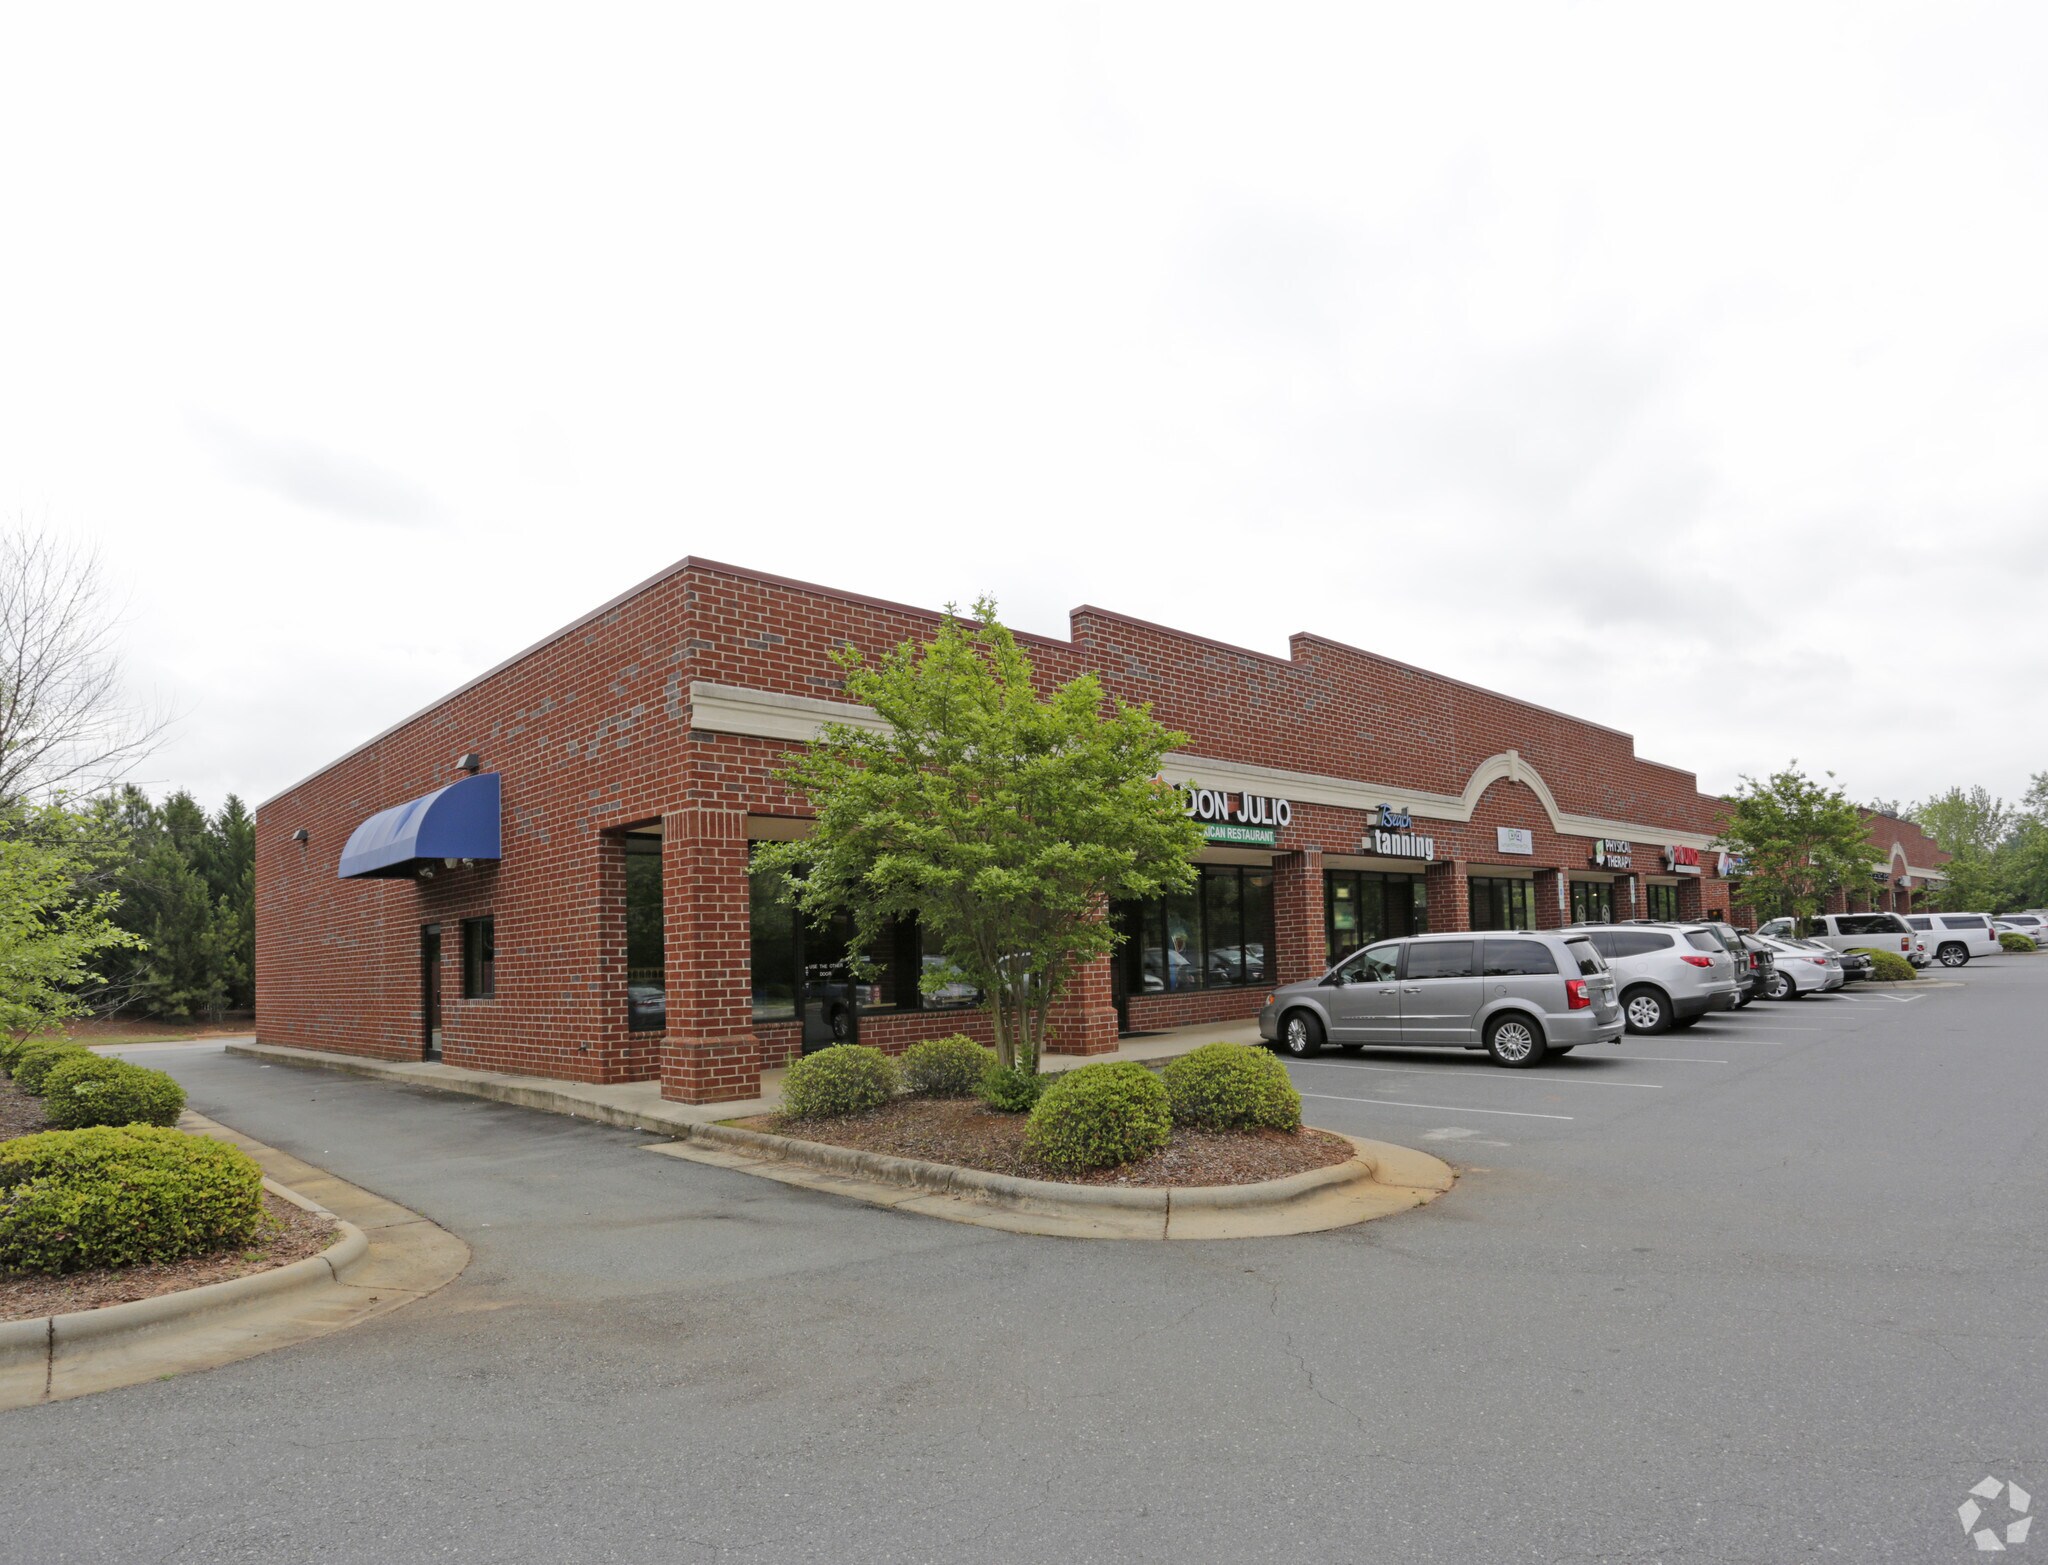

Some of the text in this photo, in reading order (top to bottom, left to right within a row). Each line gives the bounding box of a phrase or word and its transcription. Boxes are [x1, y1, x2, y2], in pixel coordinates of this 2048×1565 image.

[1181, 784, 1291, 826] DON JULIO
[1380, 803, 1411, 828] Beach
[1201, 826, 1274, 842] XICAN RESTAURANT
[1375, 829, 1434, 861] tanning
[1605, 839, 1632, 853] PHYSICAL
[1607, 855, 1632, 868] THERAPY
